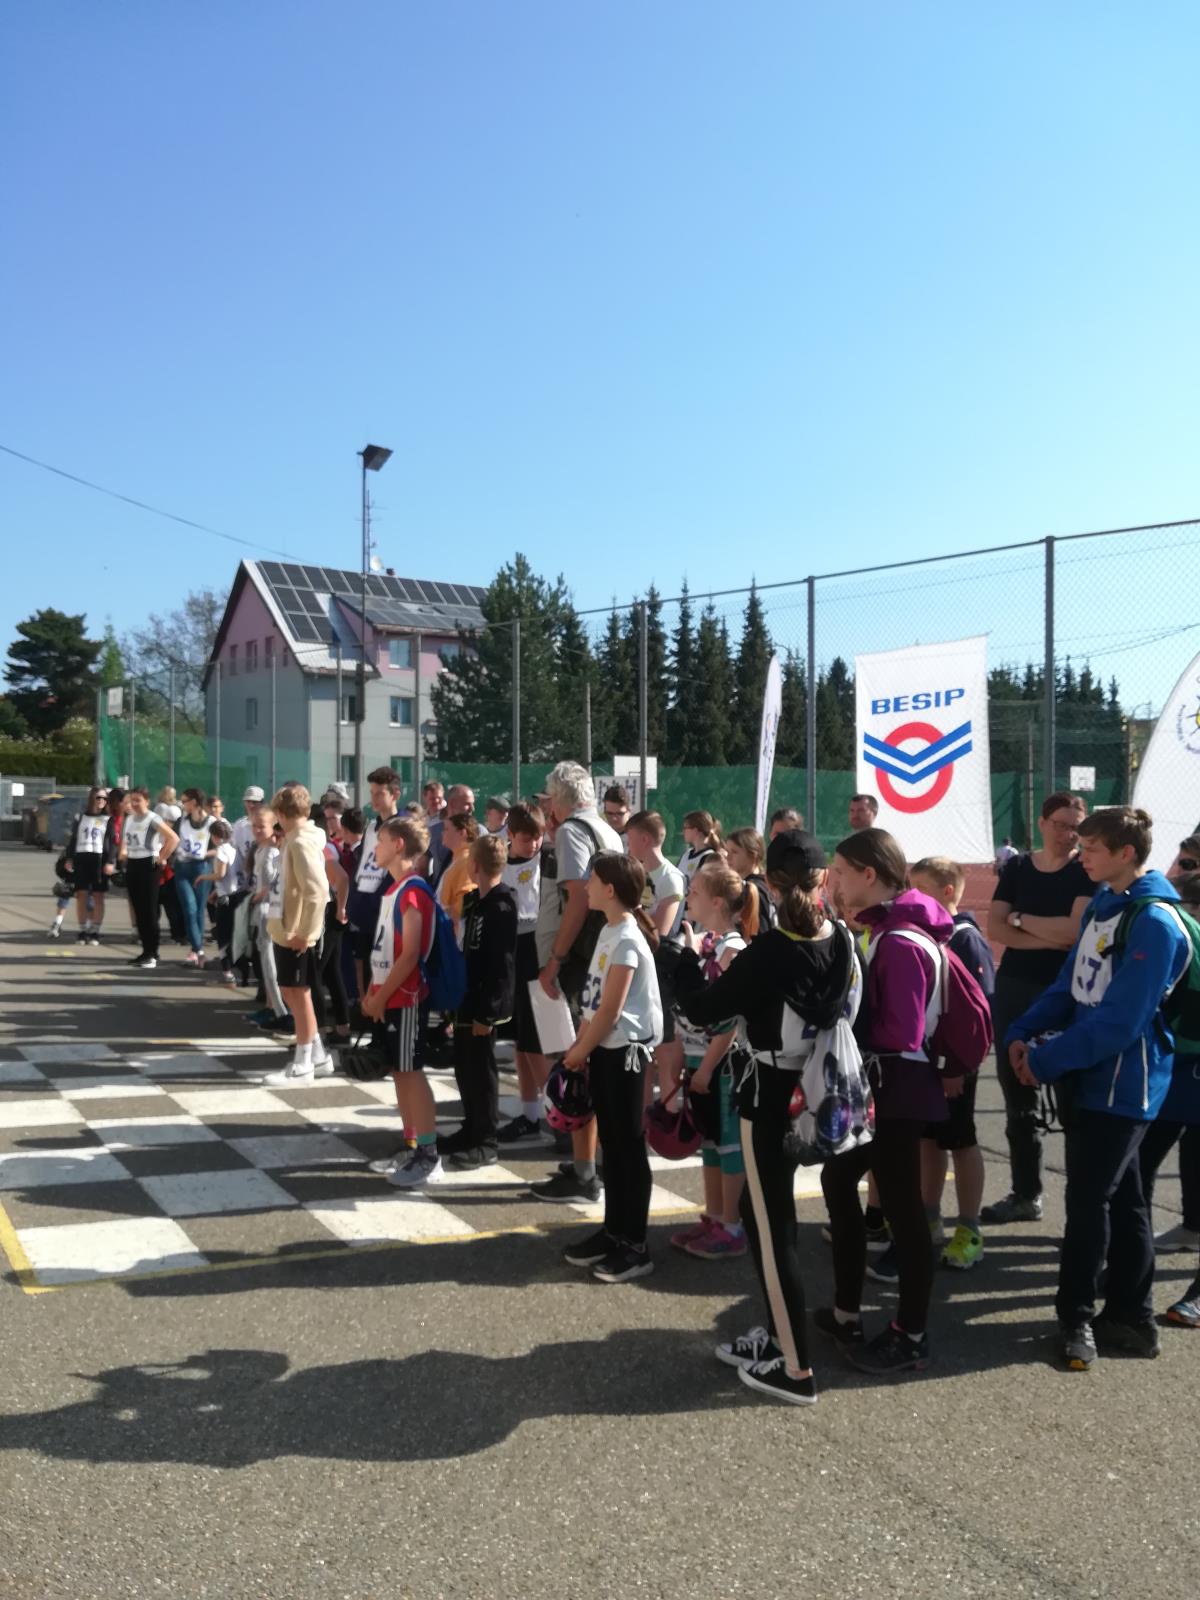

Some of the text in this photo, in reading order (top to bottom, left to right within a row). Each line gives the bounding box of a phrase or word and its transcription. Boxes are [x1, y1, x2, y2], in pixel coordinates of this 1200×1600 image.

[871, 688, 965, 715] BESIP
[125, 832, 141, 847] 31
[183, 838, 202, 857] 32
